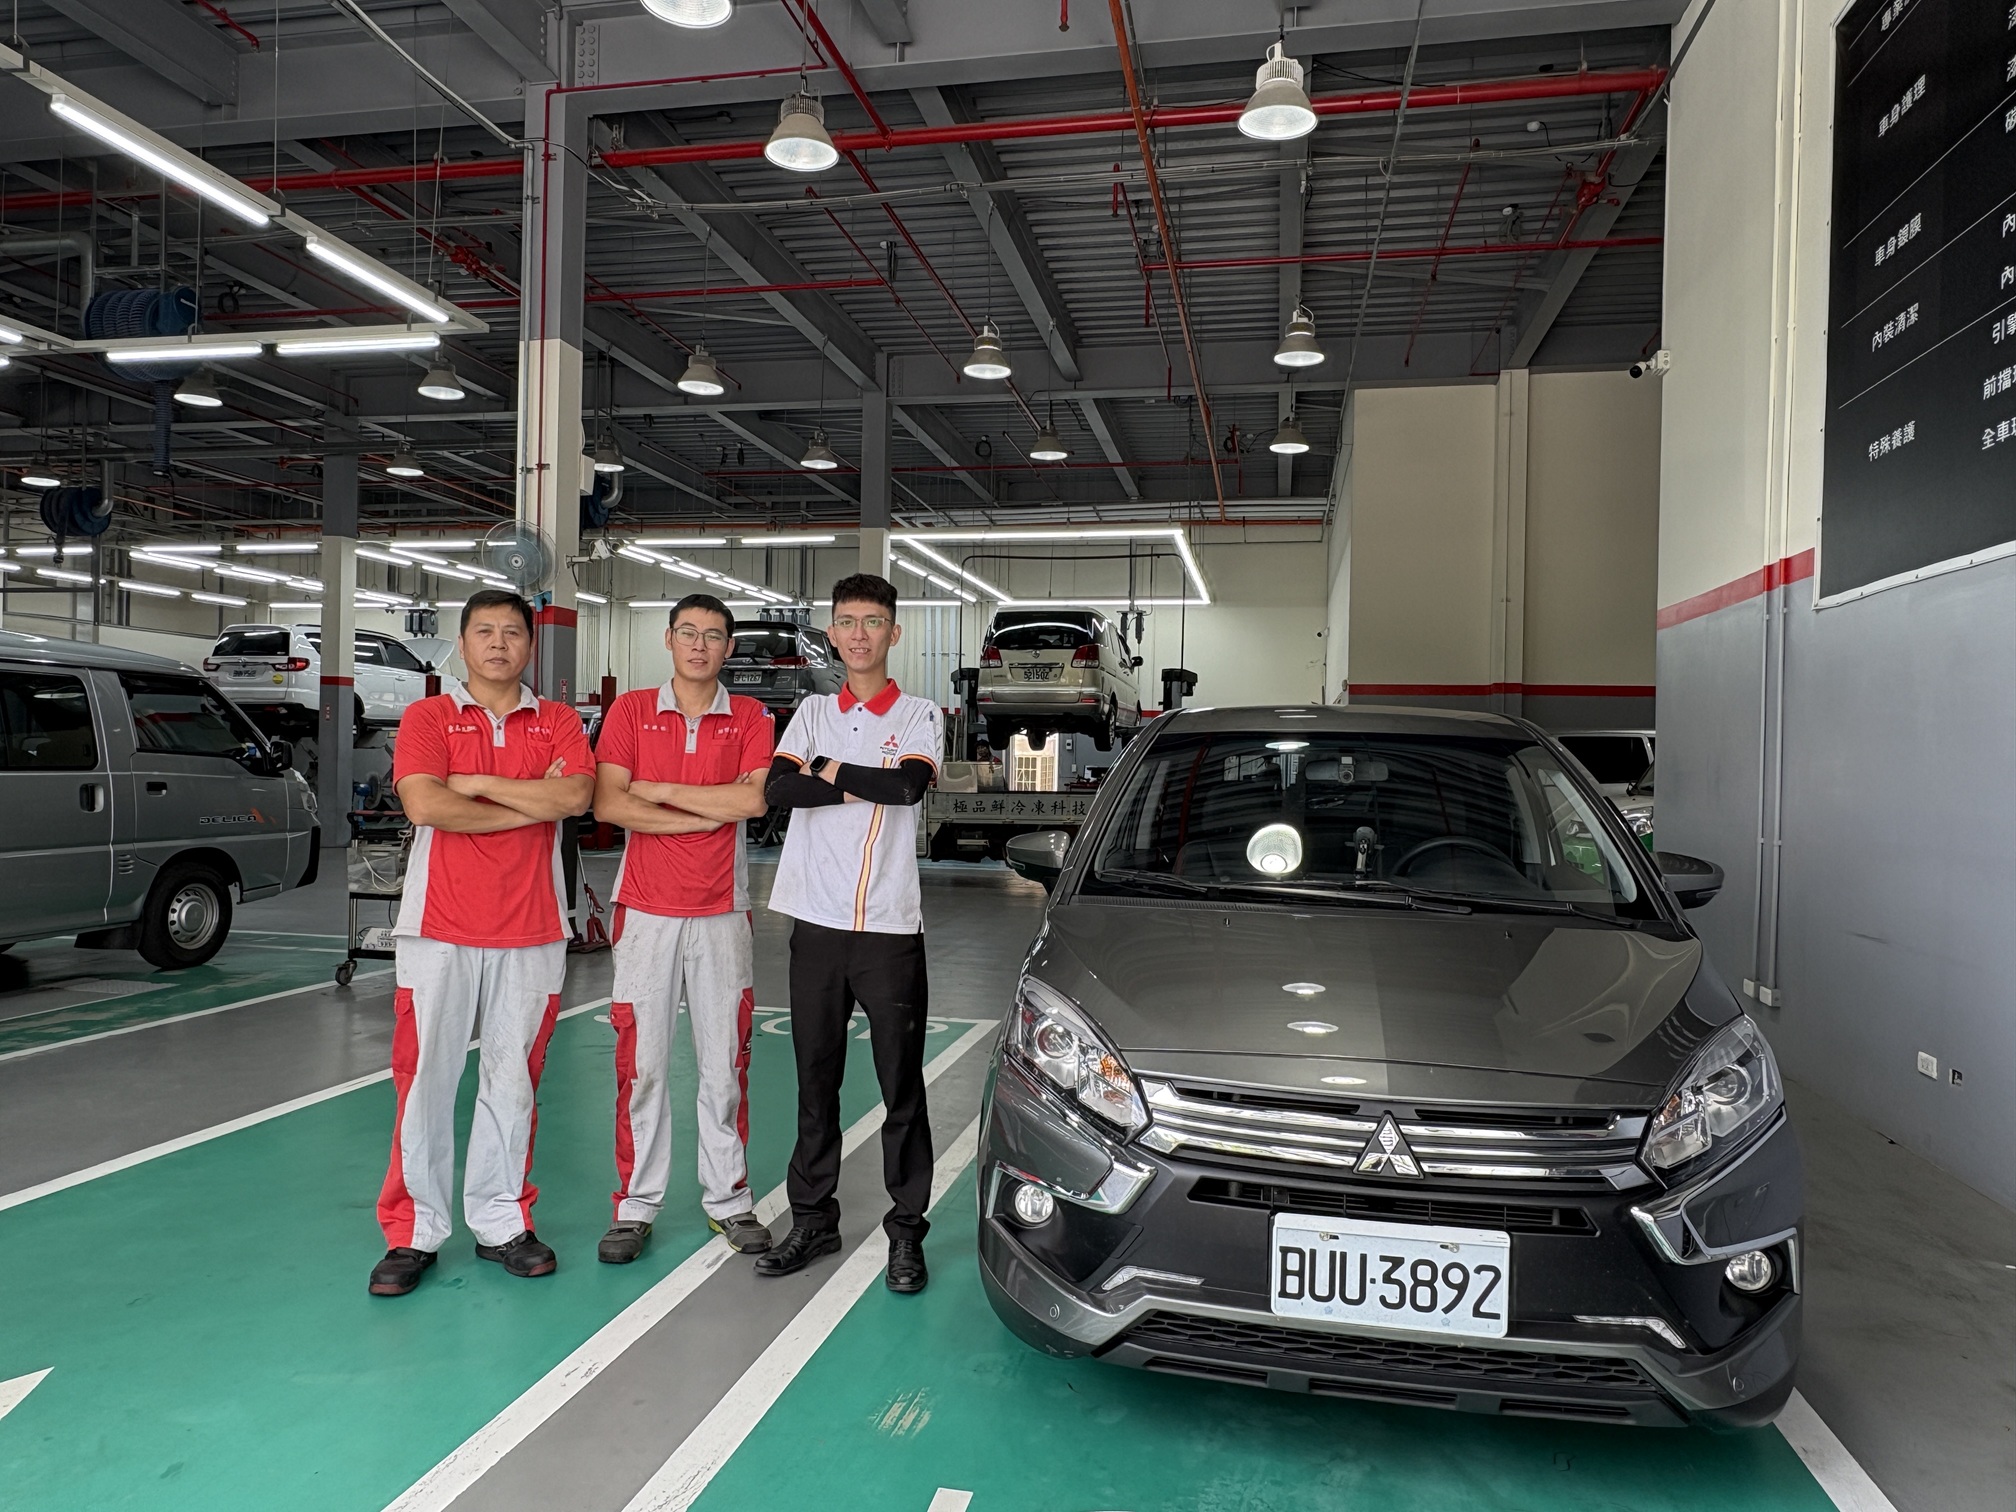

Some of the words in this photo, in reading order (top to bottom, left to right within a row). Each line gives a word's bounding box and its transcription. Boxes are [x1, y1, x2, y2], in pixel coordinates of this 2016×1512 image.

[1874, 212, 1922, 266] 車身鍍膜
[1872, 302, 1919, 352] 內裝清潔
[1869, 420, 1915, 462] 特殊養護
[199, 815, 257, 825] DELICA
[953, 798, 1087, 816] 極品鮮冷凍科技
